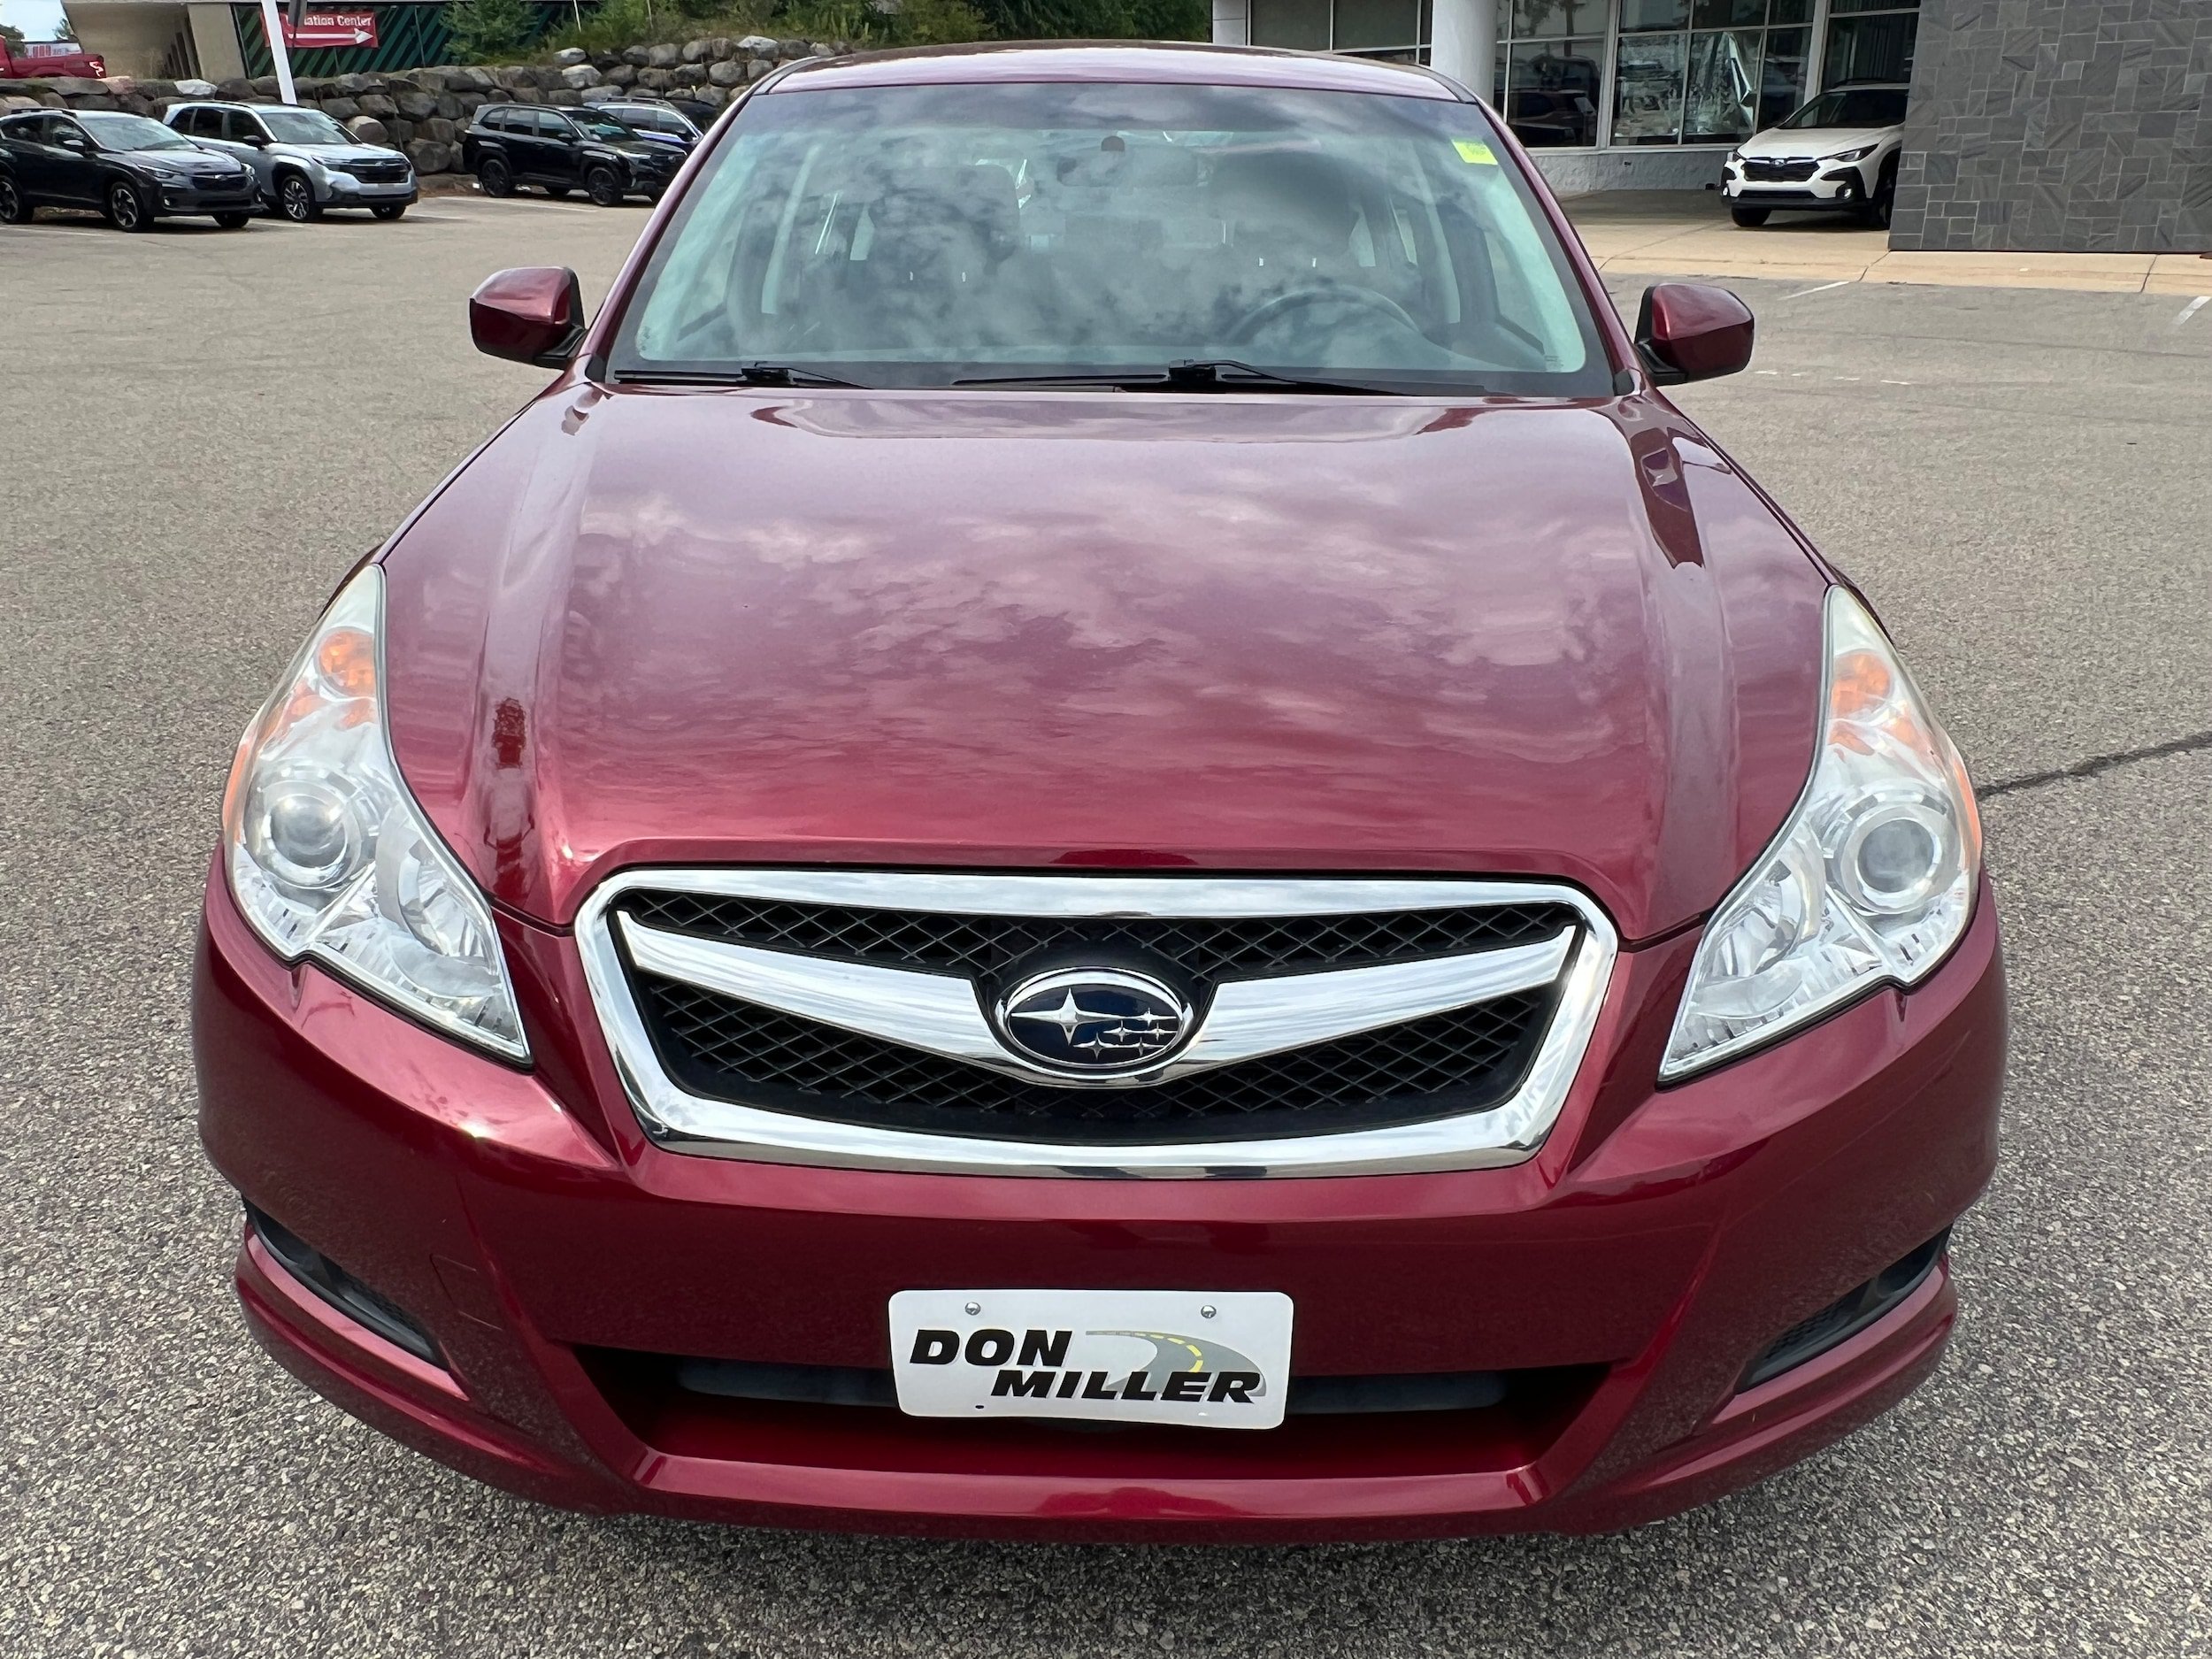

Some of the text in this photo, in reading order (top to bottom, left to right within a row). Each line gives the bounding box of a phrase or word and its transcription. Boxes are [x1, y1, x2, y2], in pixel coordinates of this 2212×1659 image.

[337, 15, 373, 27] Center
[910, 1328, 1072, 1367] DON
[990, 1370, 1262, 1404] MILLER
